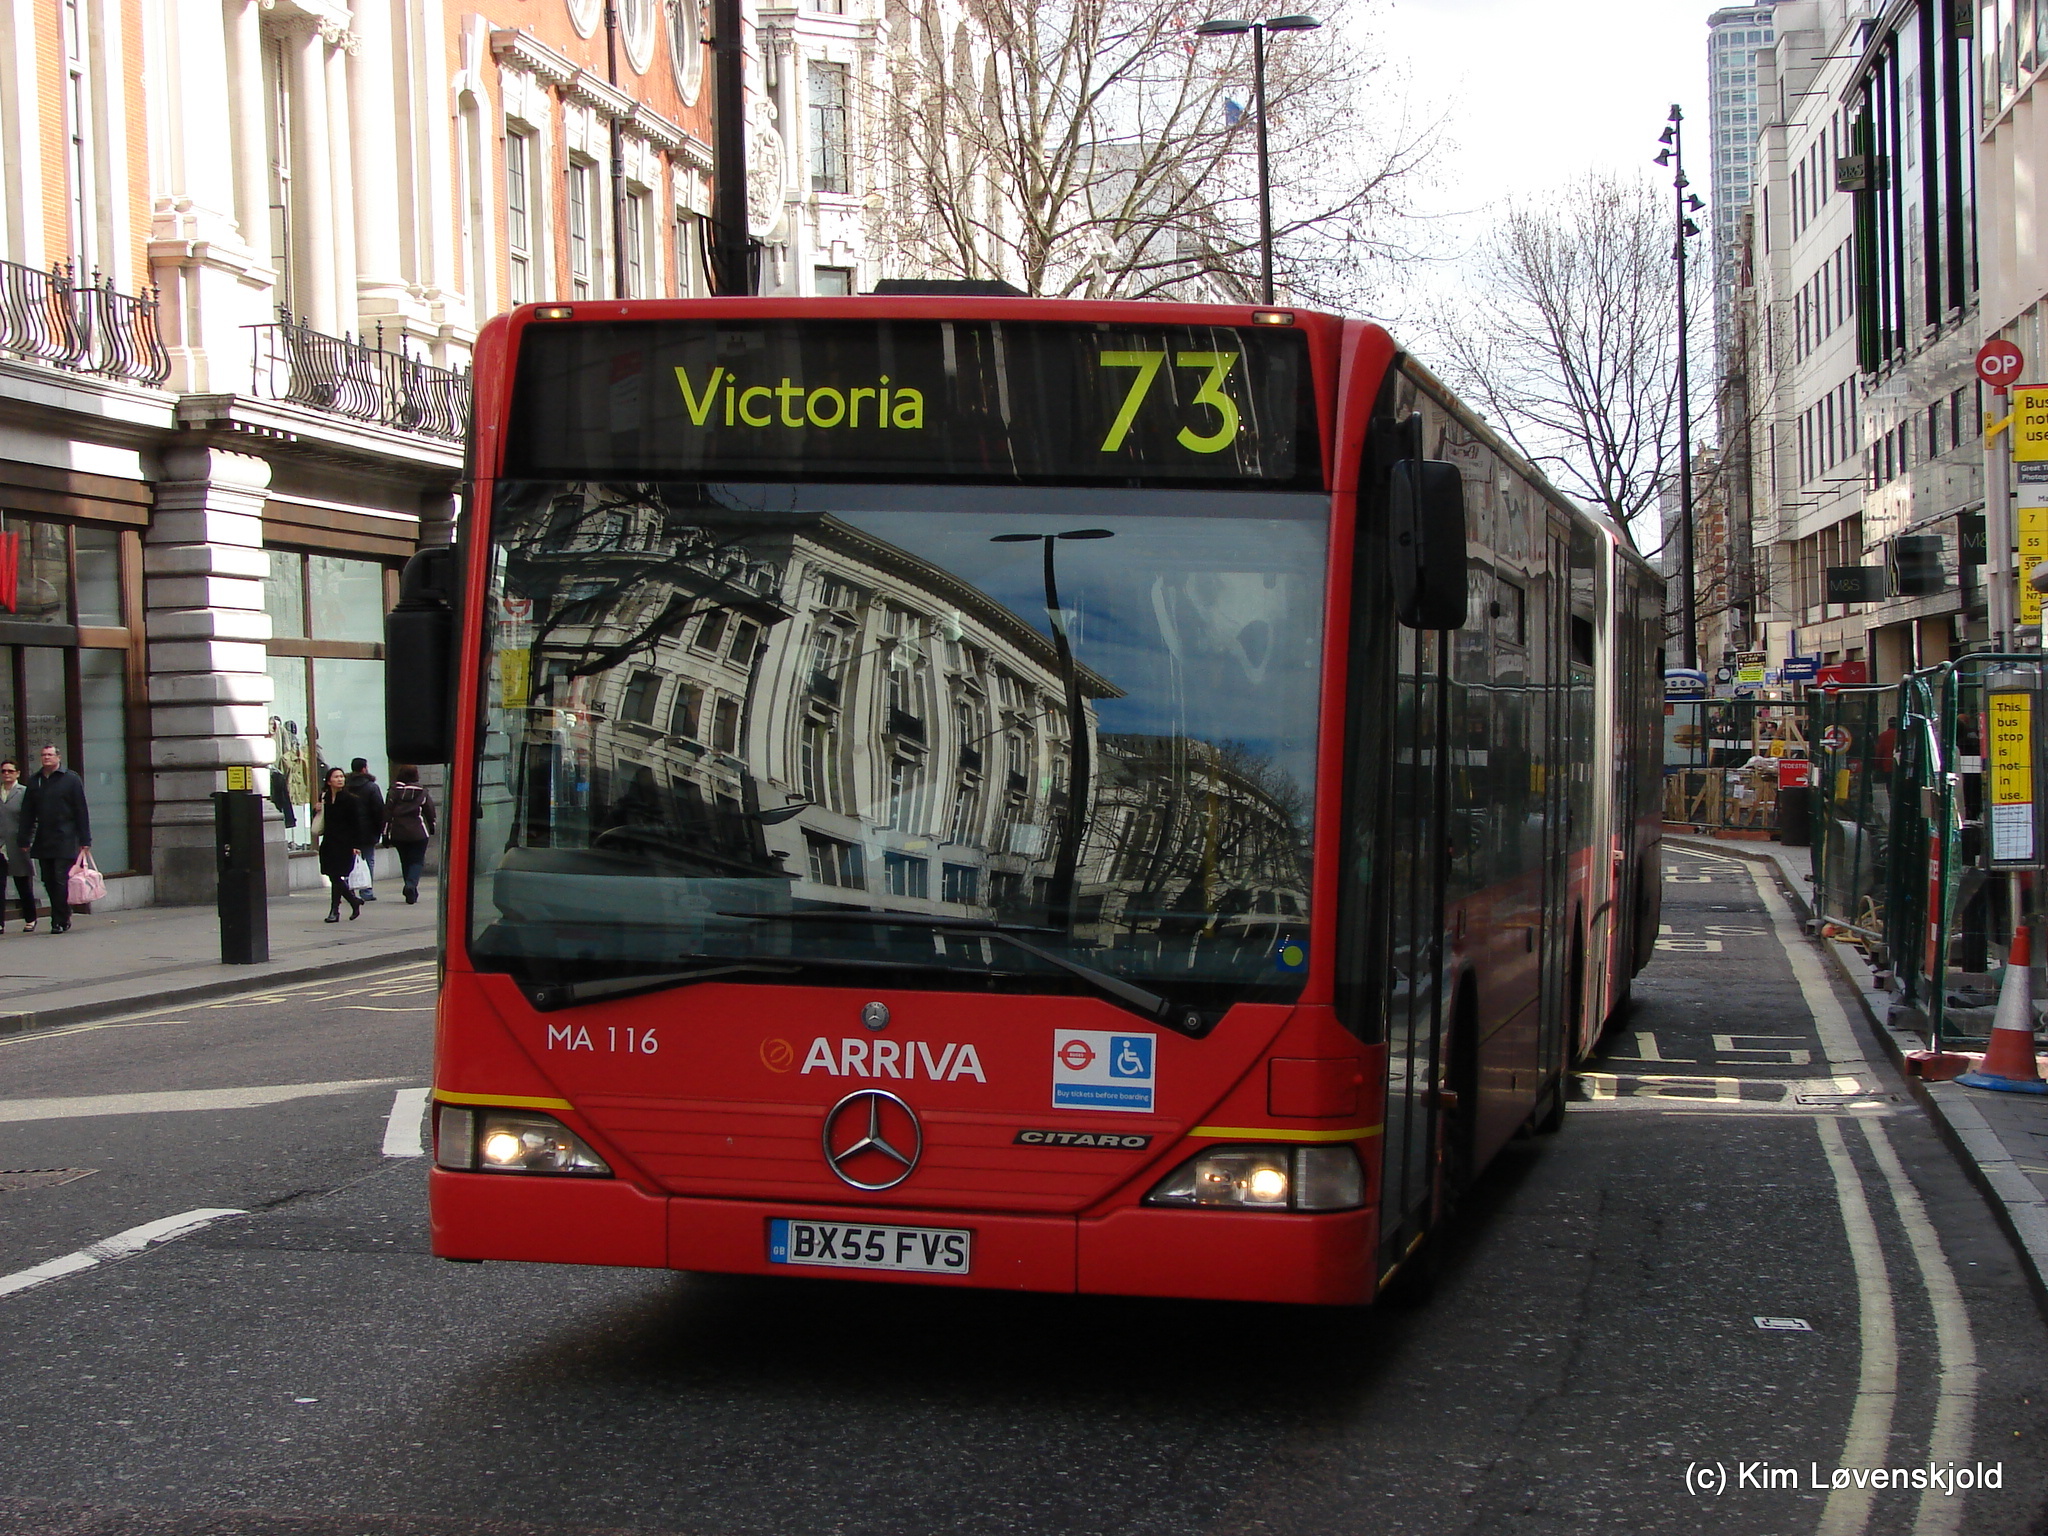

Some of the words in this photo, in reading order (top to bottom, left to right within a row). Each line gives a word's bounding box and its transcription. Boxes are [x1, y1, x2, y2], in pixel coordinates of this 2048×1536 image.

[1981, 355, 2017, 374] OP
[674, 366, 924, 429] Victoria
[1100, 351, 1240, 454] 73
[2028, 514, 2035, 523] 7
[2027, 538, 2040, 547] 55
[1830, 578, 1860, 592] M&S
[1996, 702, 2021, 712] This
[1997, 718, 2018, 727] bus
[1997, 733, 2024, 743] stop
[1998, 747, 2008, 756] is
[1999, 761, 2020, 771] not
[1999, 776, 2010, 785] in
[2000, 790, 2024, 800] use.
[547, 1024, 594, 1051] MA
[608, 1026, 659, 1054] 116
[800, 1036, 987, 1083] ARRIVA
[1057, 1090, 1070, 1098] Buy
[1071, 1090, 1094, 1098] tickets
[1095, 1091, 1118, 1100] before
[1119, 1093, 1149, 1102] boarding
[1020, 1131, 1146, 1148] CITARO
[794, 1225, 886, 1263] BX55
[895, 1231, 965, 1267] FVS
